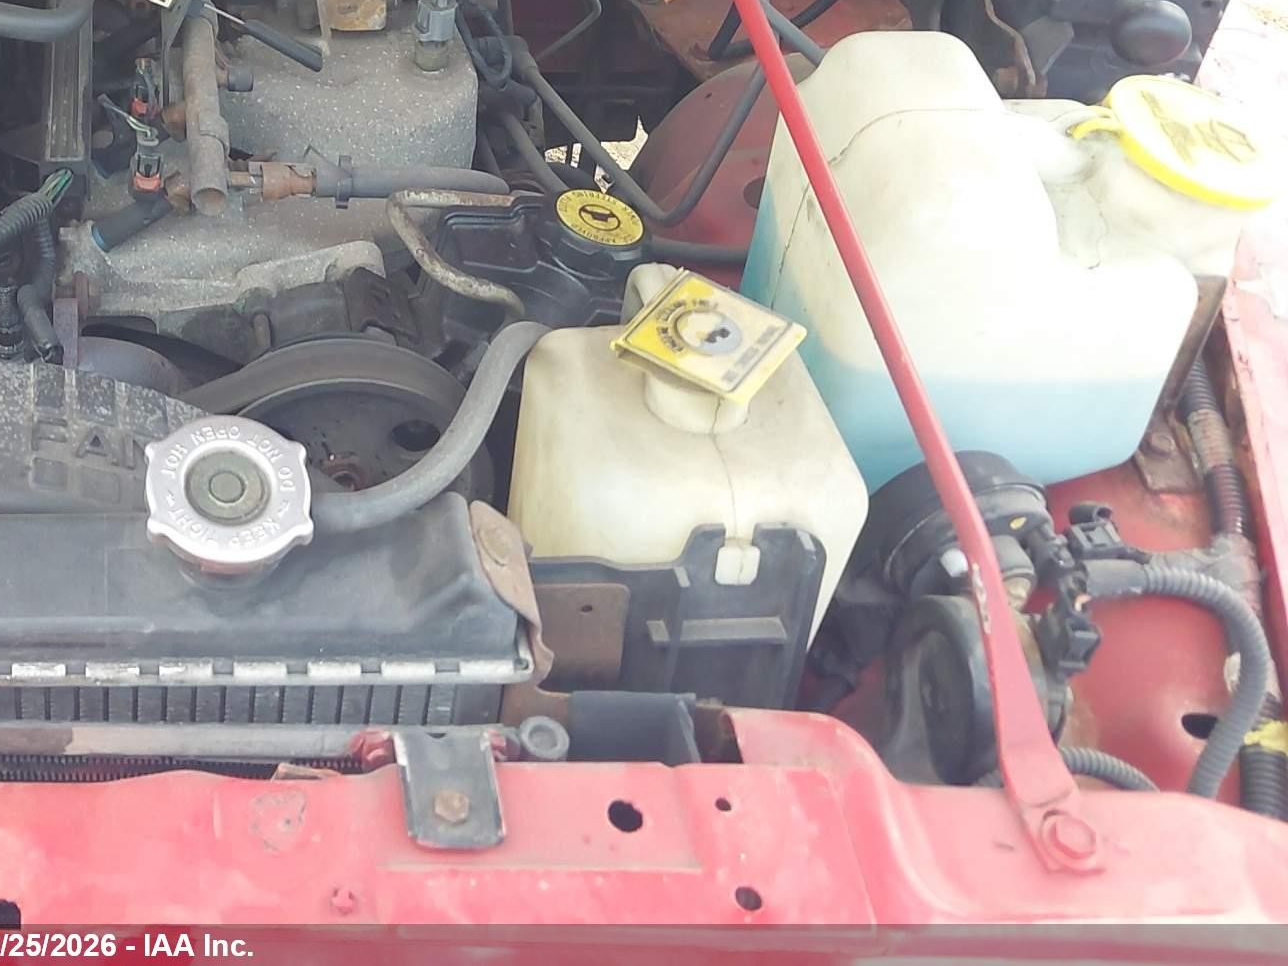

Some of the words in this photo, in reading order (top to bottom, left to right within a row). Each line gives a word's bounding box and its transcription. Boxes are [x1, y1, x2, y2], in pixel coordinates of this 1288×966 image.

[190, 425, 241, 446] OPEN
[247, 433, 283, 463] NOT
[161, 444, 188, 479] HOT
[278, 467, 296, 491] DO
